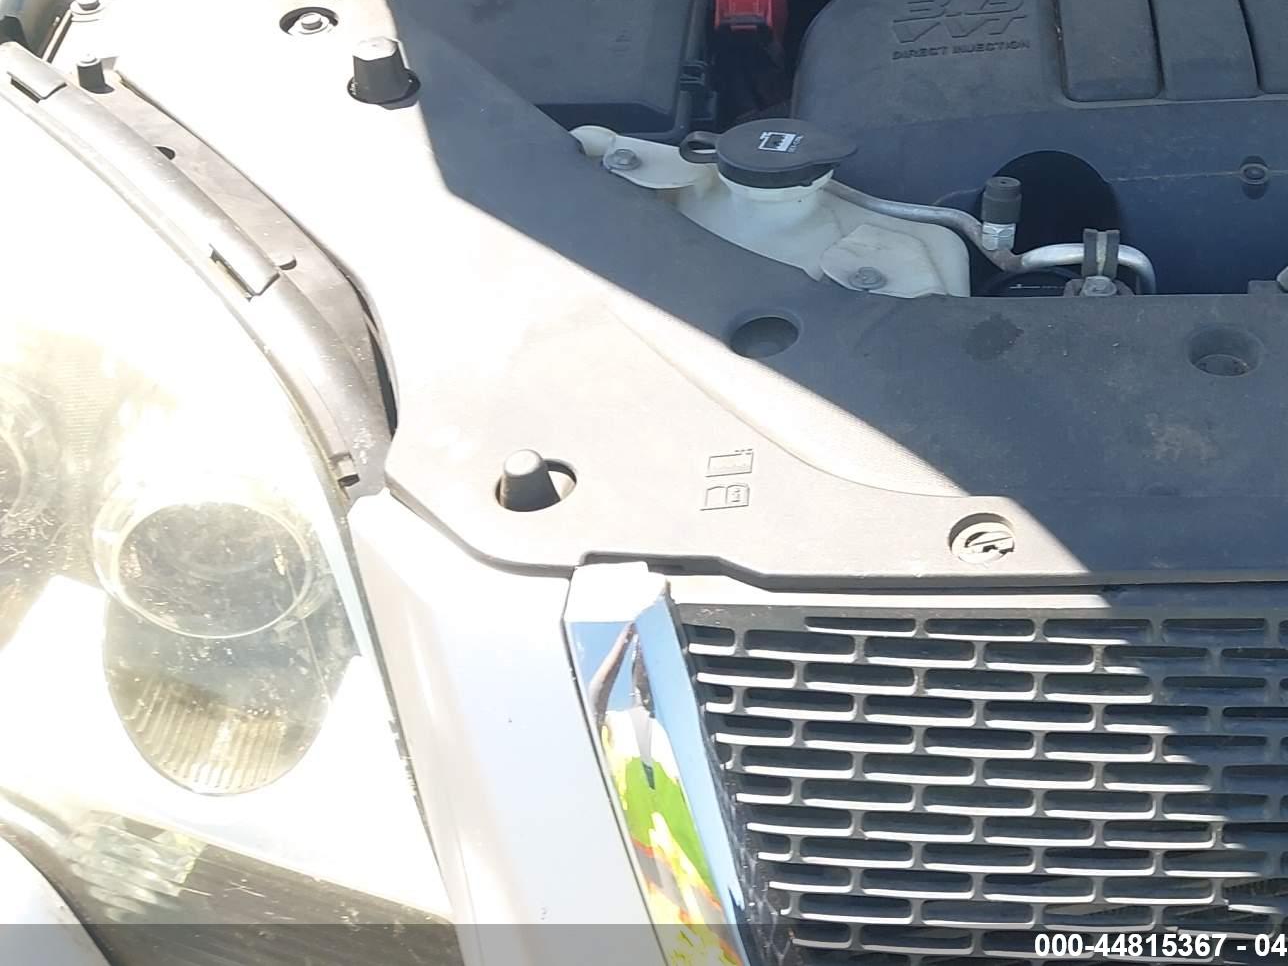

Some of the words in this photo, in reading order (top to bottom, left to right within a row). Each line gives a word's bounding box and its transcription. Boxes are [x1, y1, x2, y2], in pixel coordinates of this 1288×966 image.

[892, 15, 1028, 44] VVT
[891, 46, 948, 60] DIRECT
[951, 39, 1031, 54] INJECTION
